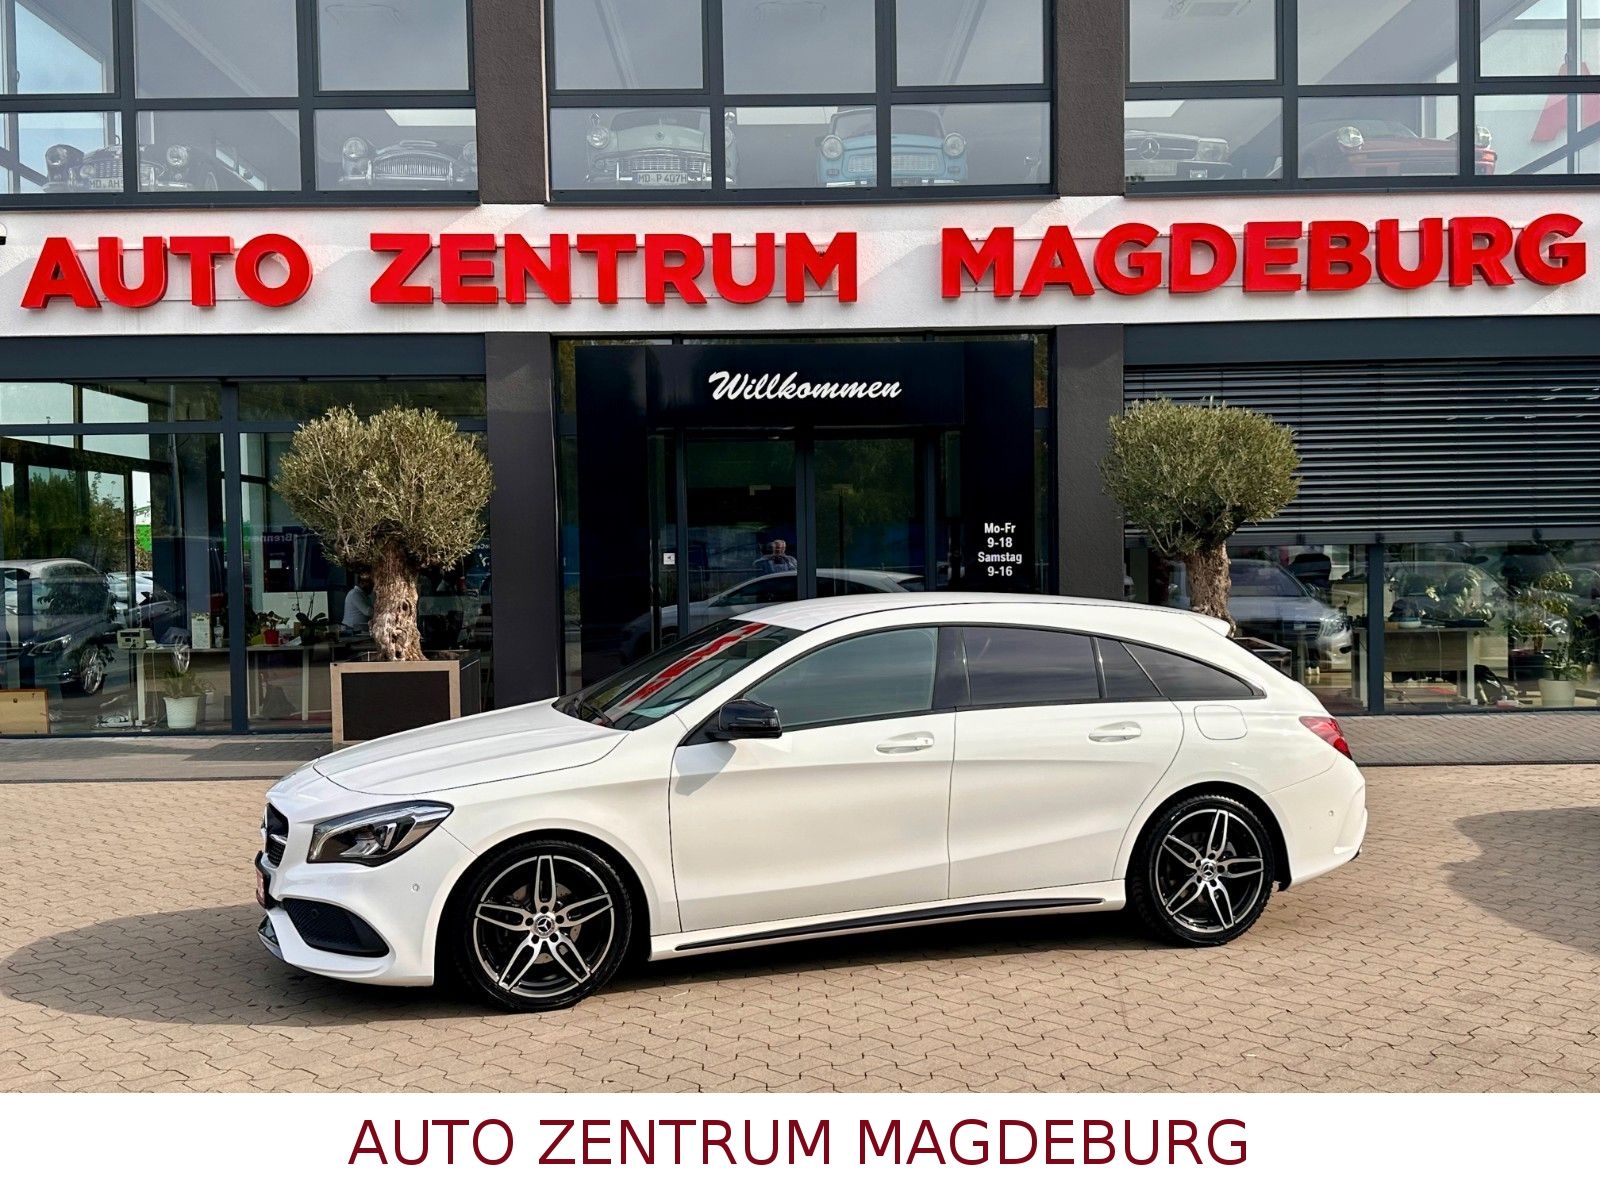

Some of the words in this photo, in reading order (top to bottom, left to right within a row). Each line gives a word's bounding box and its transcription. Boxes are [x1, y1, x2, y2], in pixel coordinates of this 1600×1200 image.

[22, 234, 313, 309] AUTO
[370, 232, 858, 305] ZENTRUM
[941, 213, 1587, 298] MAGDEBURG
[708, 370, 903, 401] Willkommen
[984, 522, 1016, 534] Mo-Fr
[987, 536, 1013, 548] 9-18
[977, 551, 1023, 565] Samstag
[987, 565, 1013, 577] 9-16
